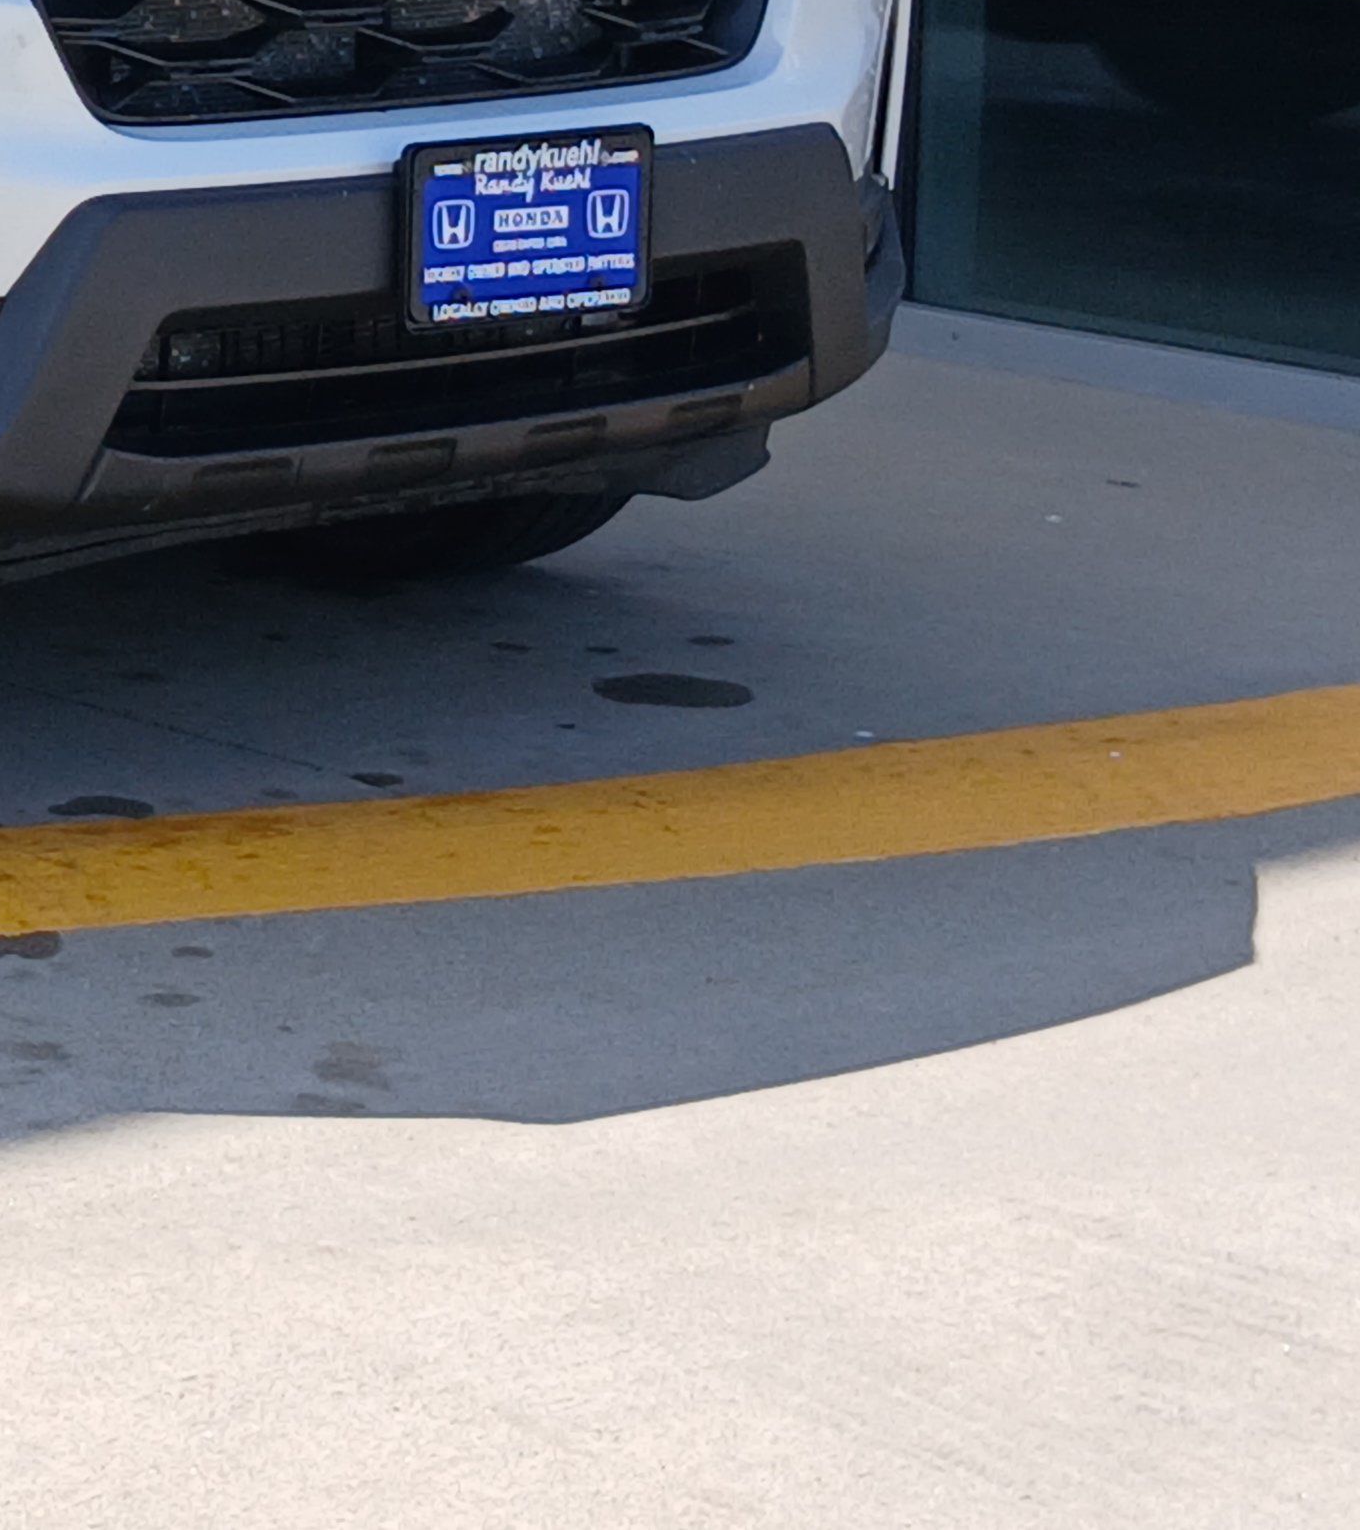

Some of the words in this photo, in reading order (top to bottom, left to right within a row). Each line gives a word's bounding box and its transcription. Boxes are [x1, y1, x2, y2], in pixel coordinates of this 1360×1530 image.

[475, 172, 535, 202] Randy
[540, 167, 591, 192] Kuehl
[497, 210, 564, 227] HONDA
